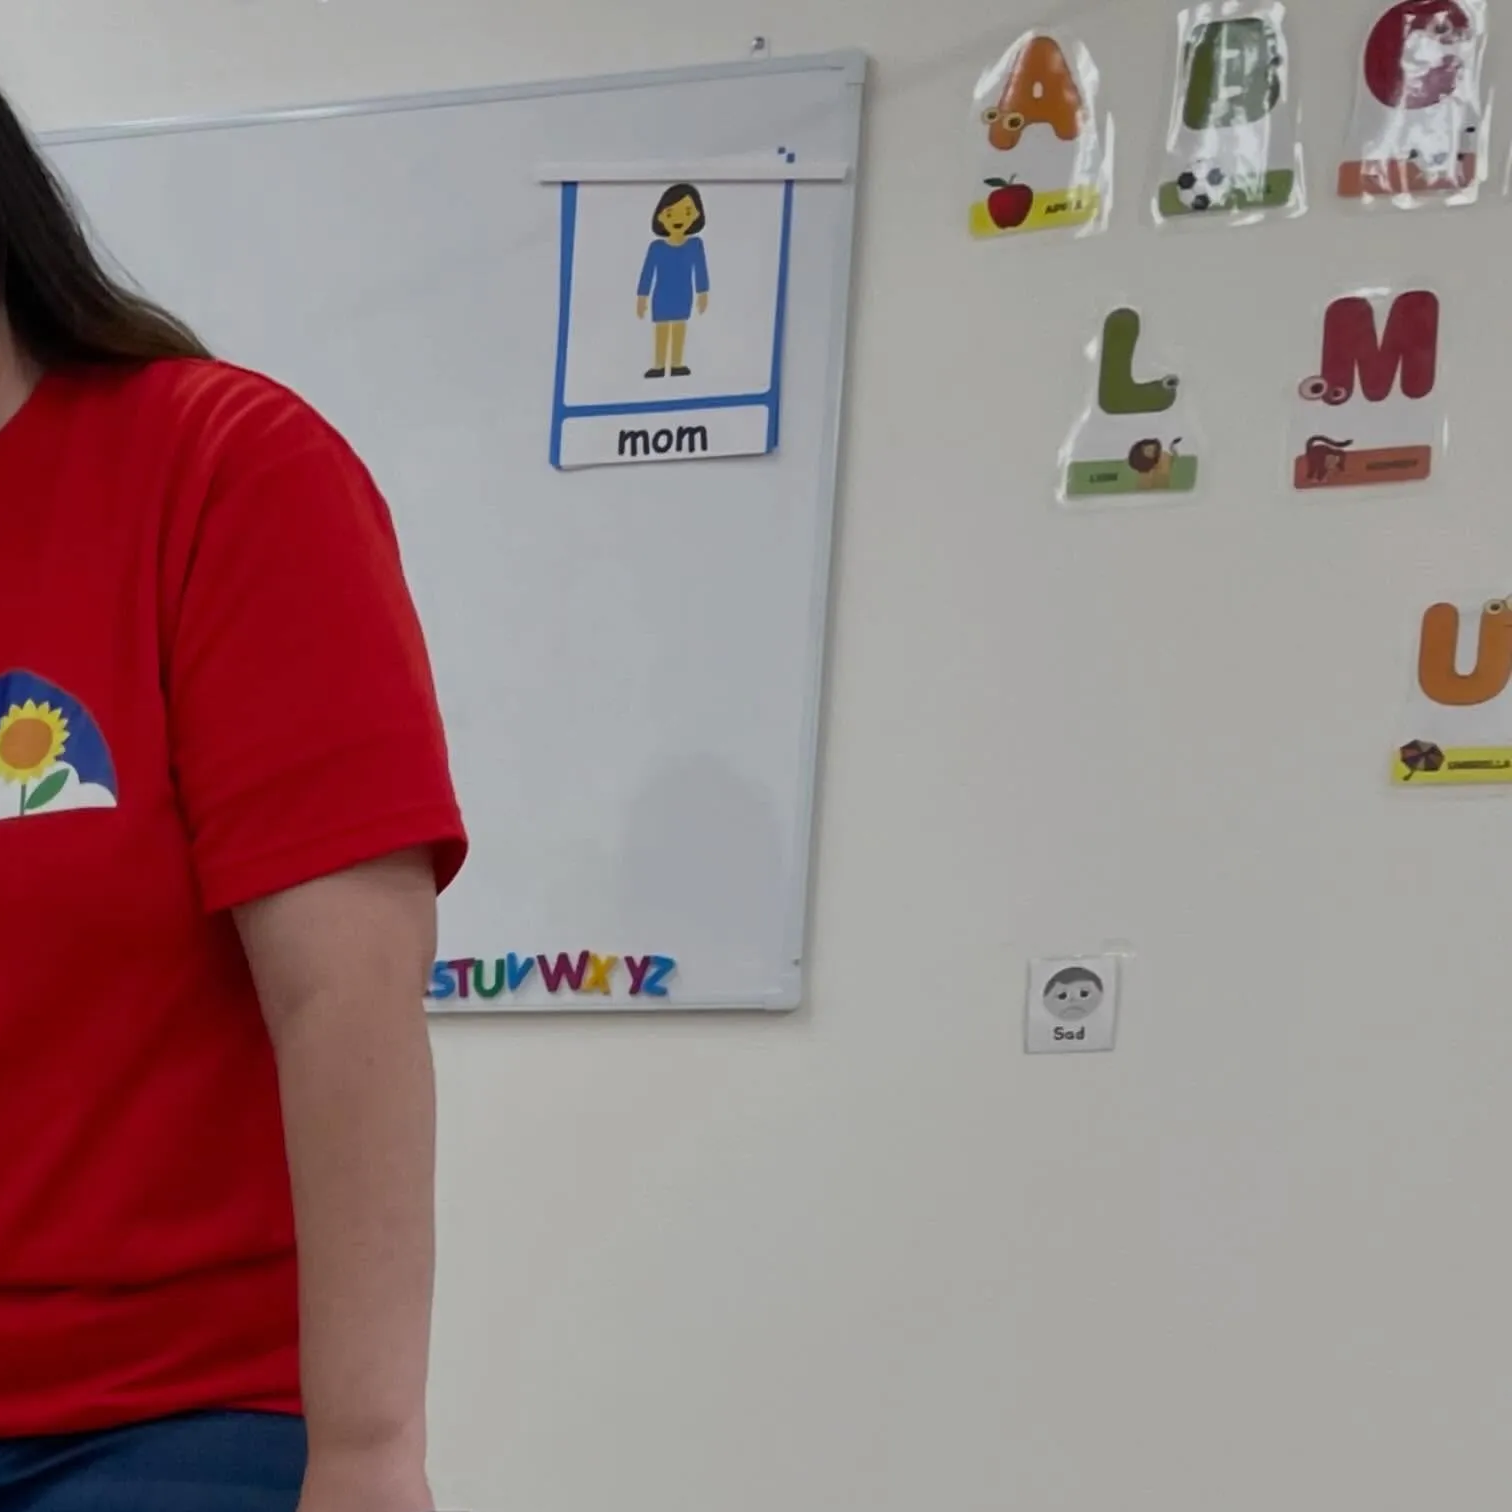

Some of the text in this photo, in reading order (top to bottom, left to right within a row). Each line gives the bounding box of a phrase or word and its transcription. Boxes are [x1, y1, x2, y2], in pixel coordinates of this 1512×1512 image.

[987, 36, 1082, 151] A
[1098, 308, 1179, 415] L
[1318, 290, 1439, 405] M
[618, 425, 708, 457] mom
[1418, 602, 1512, 706] U
[1052, 1026, 1086, 1041] Sad
